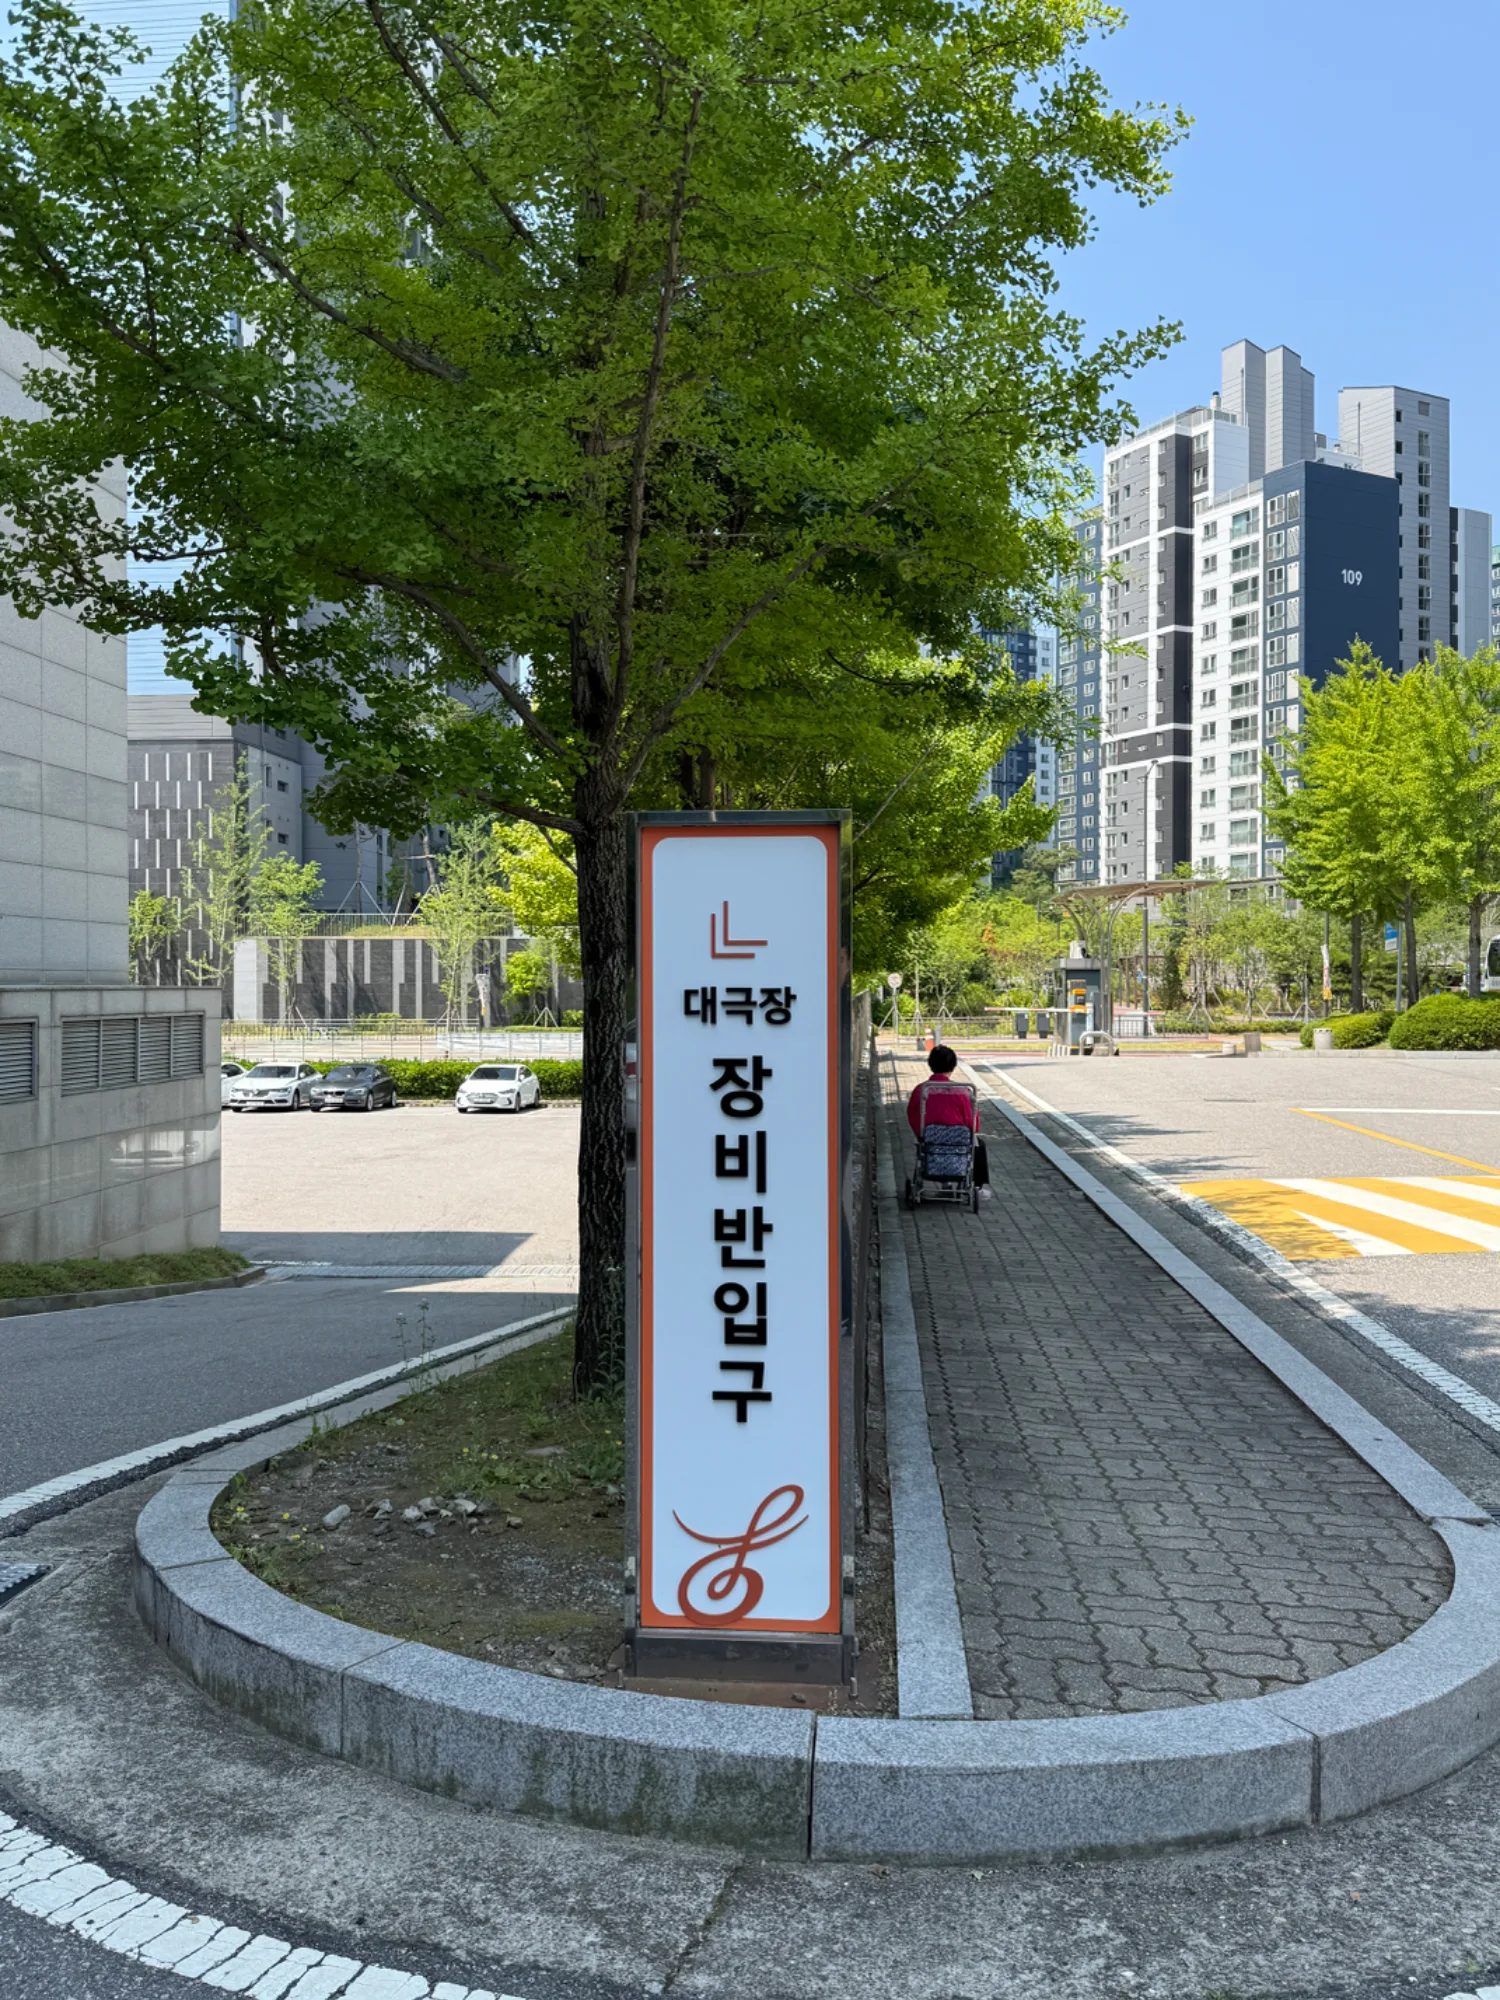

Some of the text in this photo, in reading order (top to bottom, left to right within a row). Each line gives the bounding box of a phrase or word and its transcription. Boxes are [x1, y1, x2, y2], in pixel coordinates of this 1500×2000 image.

[1340, 568, 1363, 586] 109
[683, 986, 797, 1026] 대극장
[708, 1055, 774, 1424] 장비반입구
